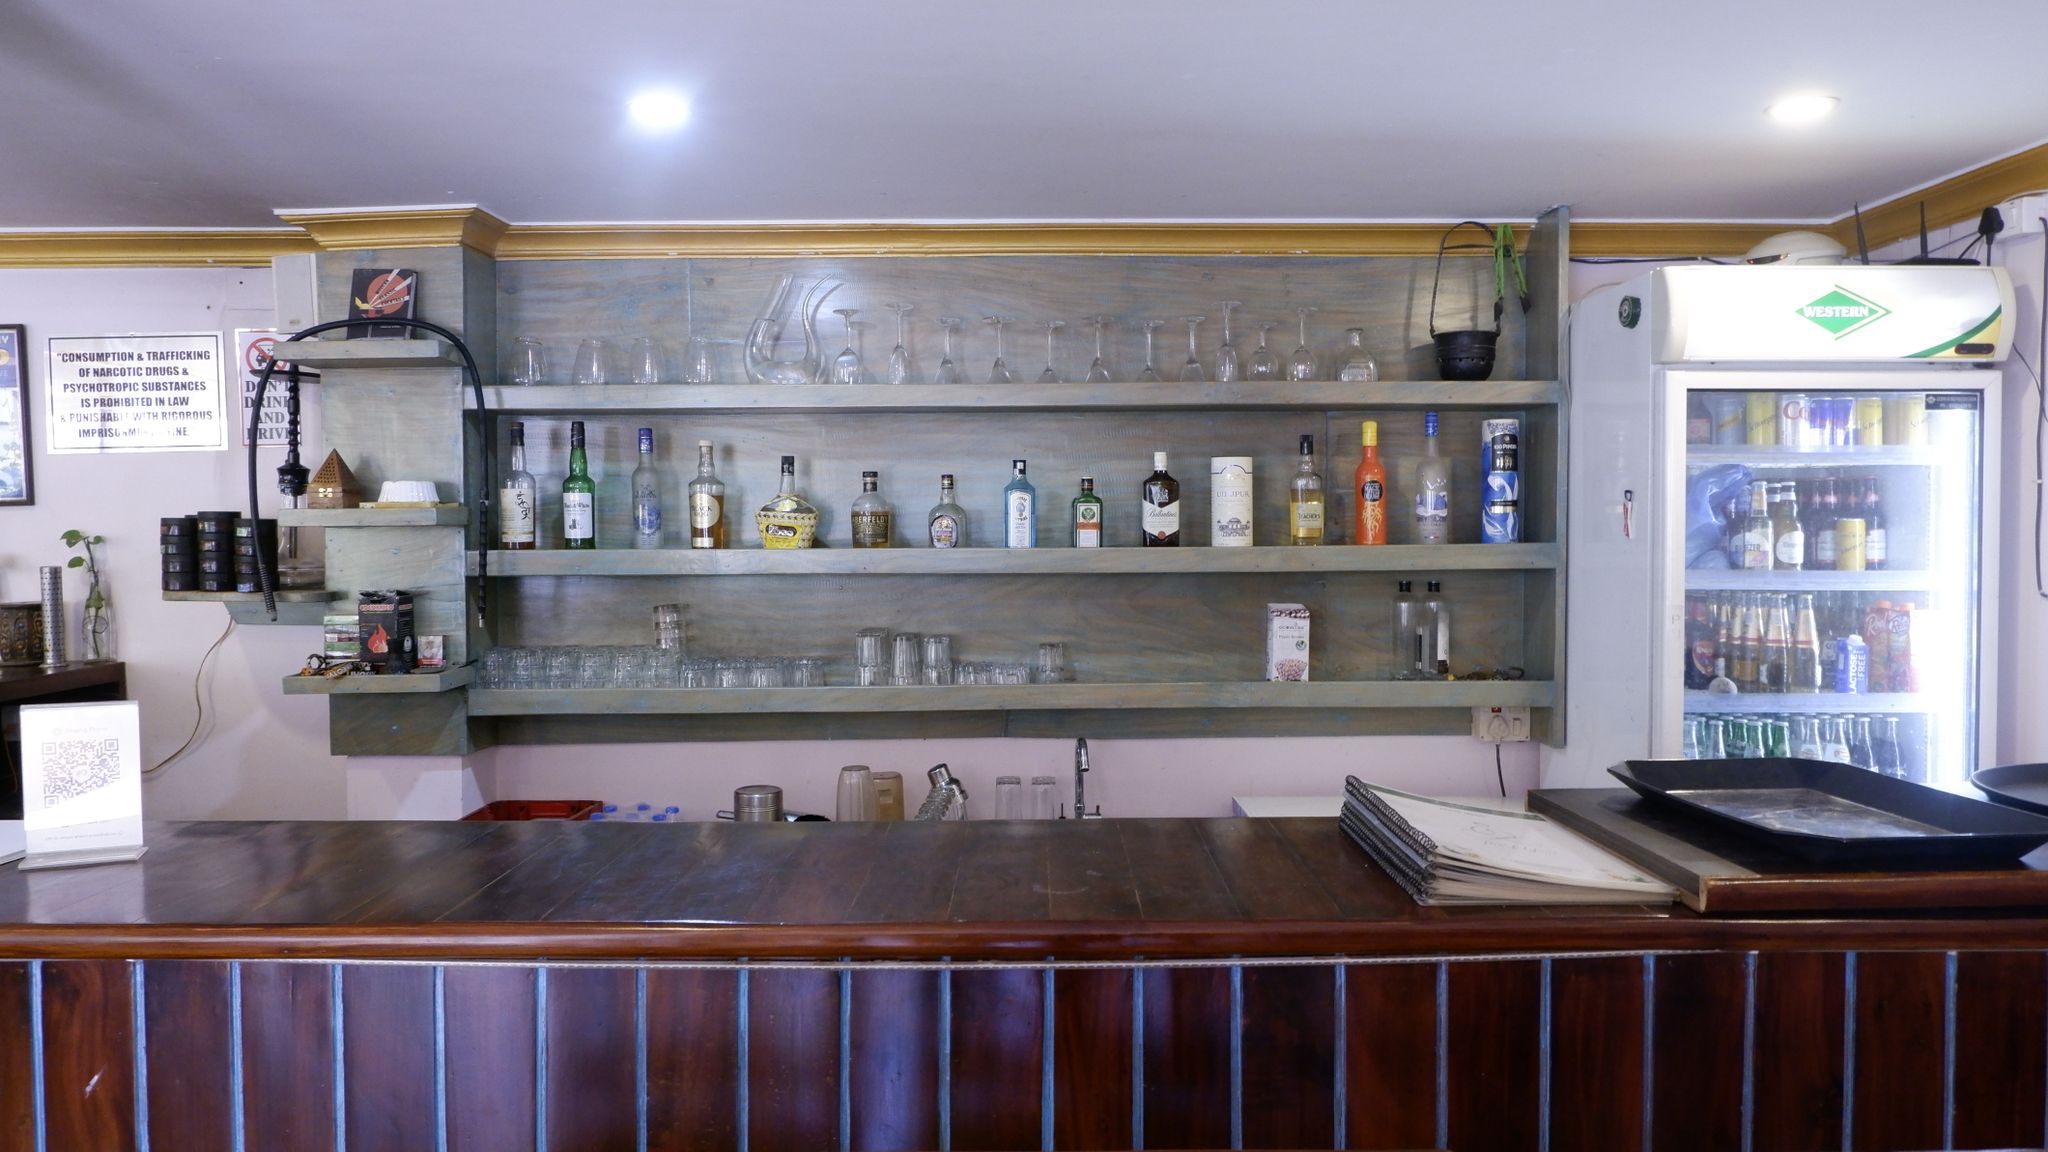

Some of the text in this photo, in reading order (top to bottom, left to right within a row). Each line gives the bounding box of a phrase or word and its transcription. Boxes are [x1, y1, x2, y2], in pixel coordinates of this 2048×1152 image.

[1803, 305, 1869, 317] WESTERN
[56, 350, 211, 363] "CONSUMPTION & TRAFFICKING
[79, 366, 189, 378] OF NARCOTIC DRUGS &
[63, 381, 206, 393] PSYCHOTROPIC SUBSTANCES
[81, 396, 189, 408] IS PROHIBITED IN LAW
[161, 410, 213, 421] RIGOROUS
[1858, 653, 1866, 678] FREE
[1849, 654, 1857, 694] LACTOSE
